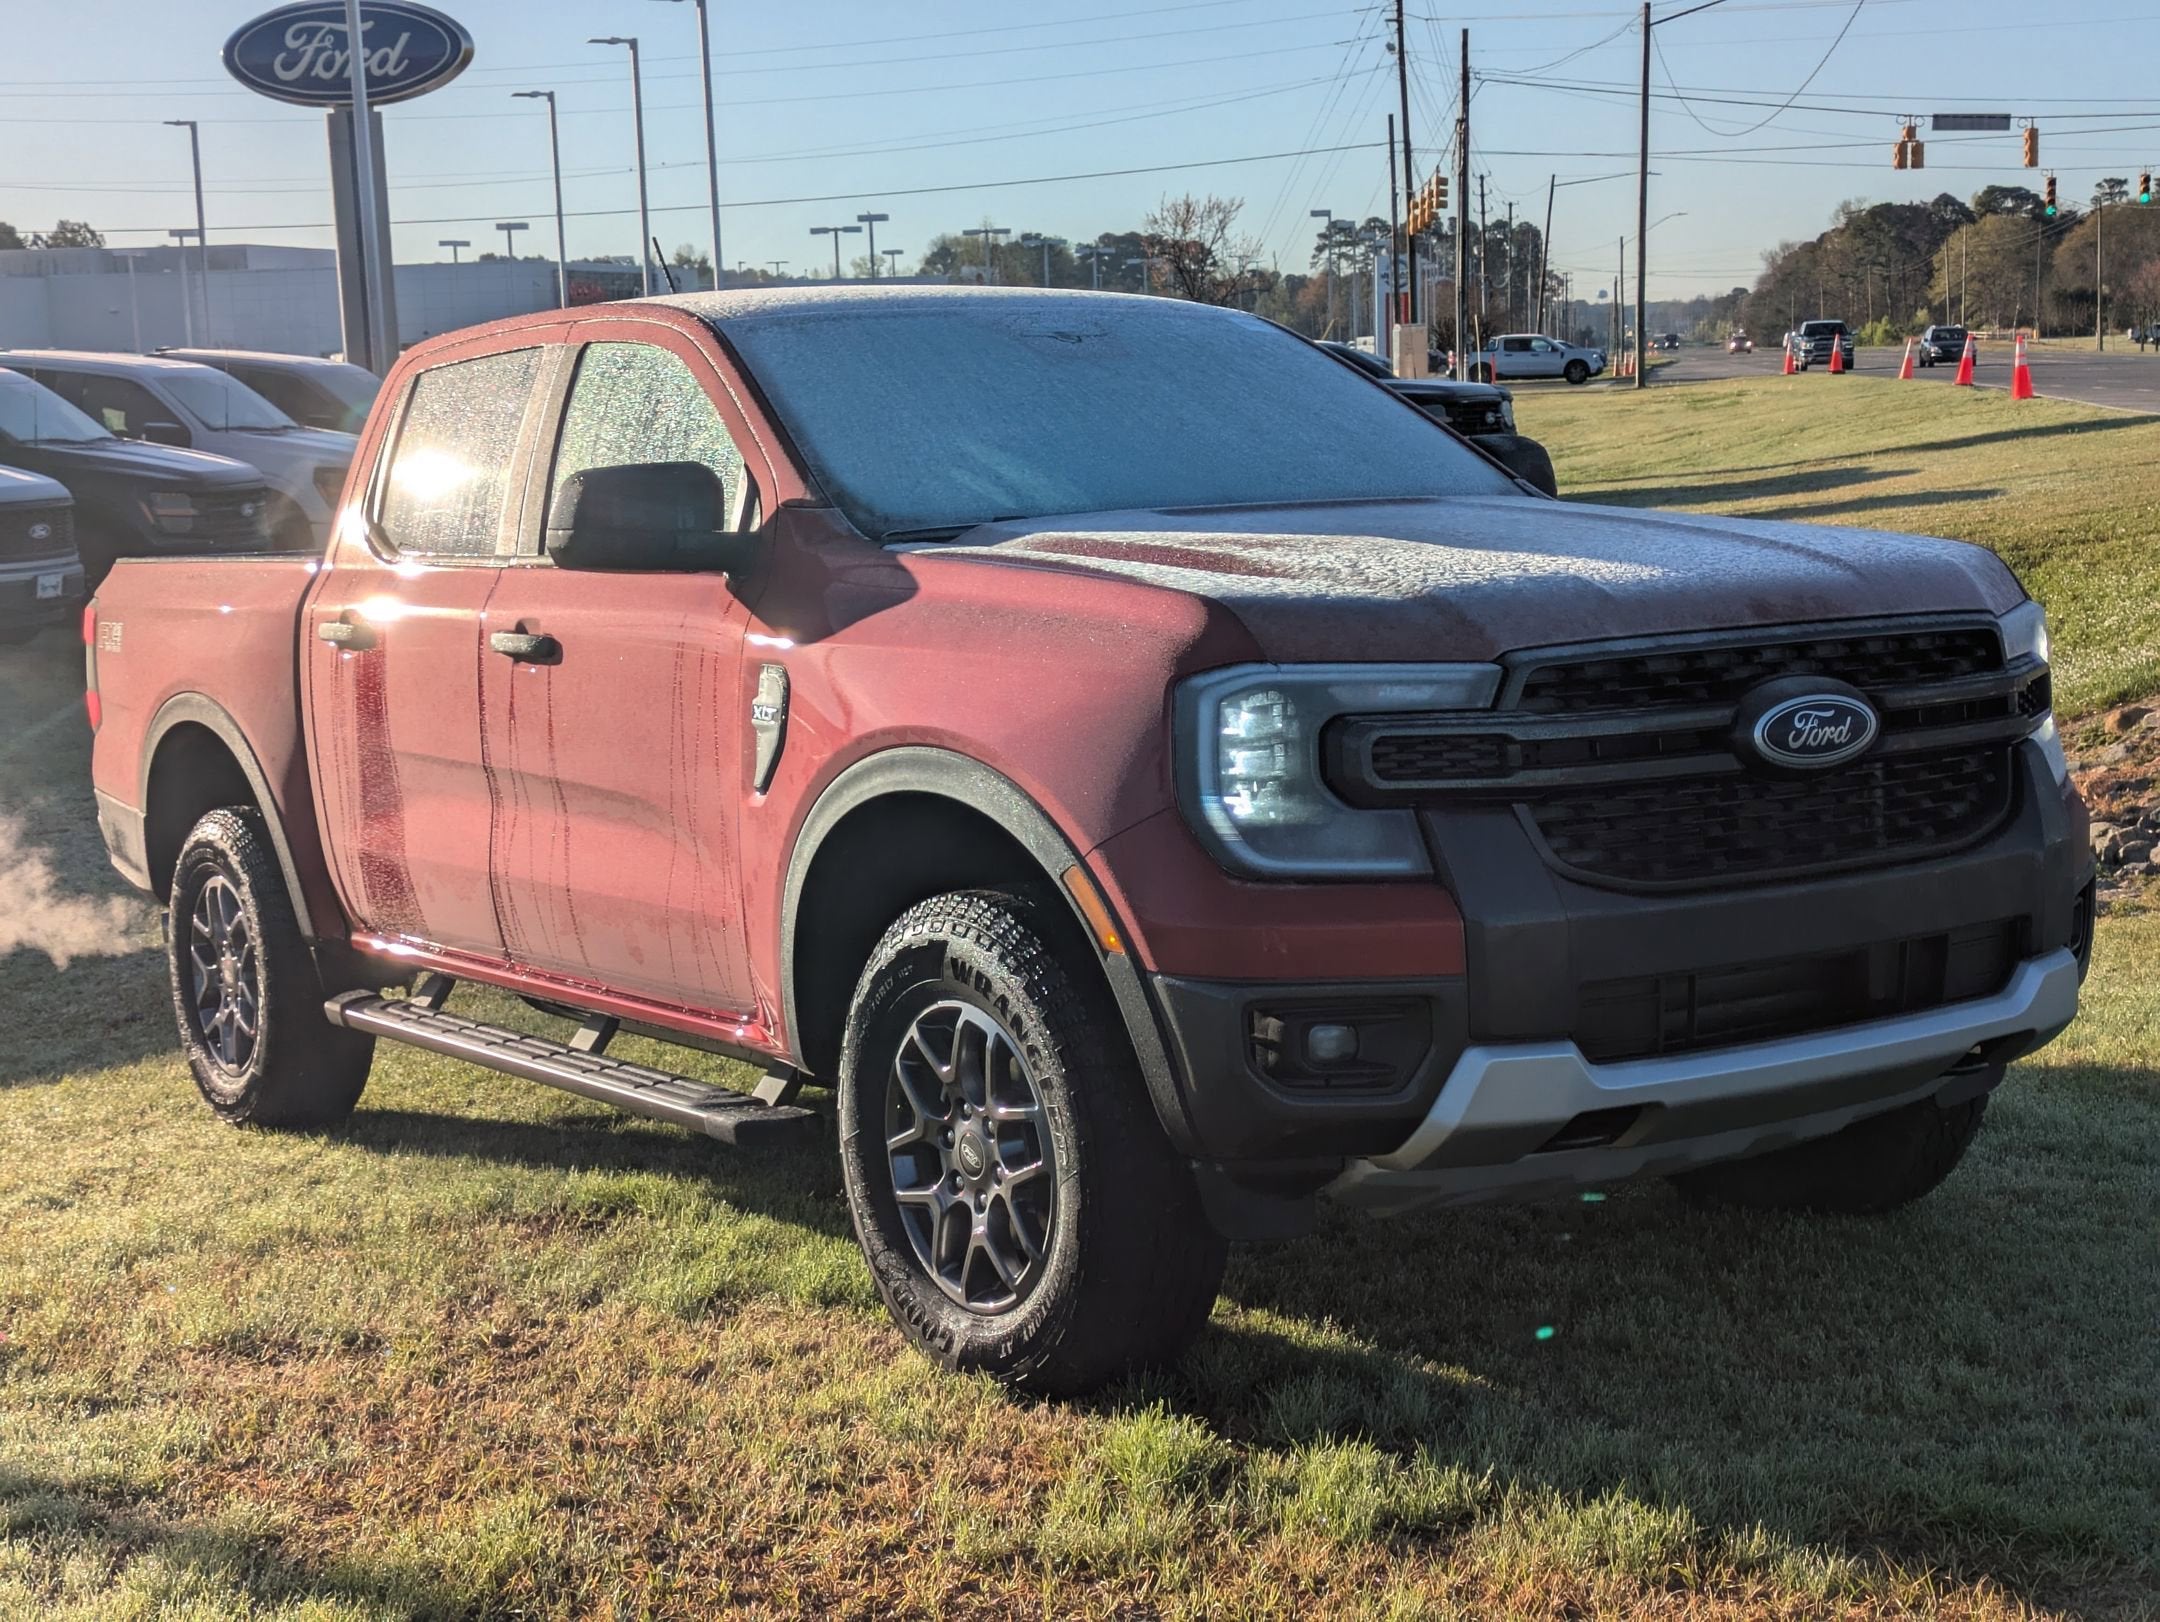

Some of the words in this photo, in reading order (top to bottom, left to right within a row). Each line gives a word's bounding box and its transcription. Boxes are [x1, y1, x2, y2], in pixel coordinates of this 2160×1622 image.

[752, 704, 778, 722] XLT
[1788, 709, 1852, 749] Ford
[949, 957, 1072, 1167] WRANGLER
